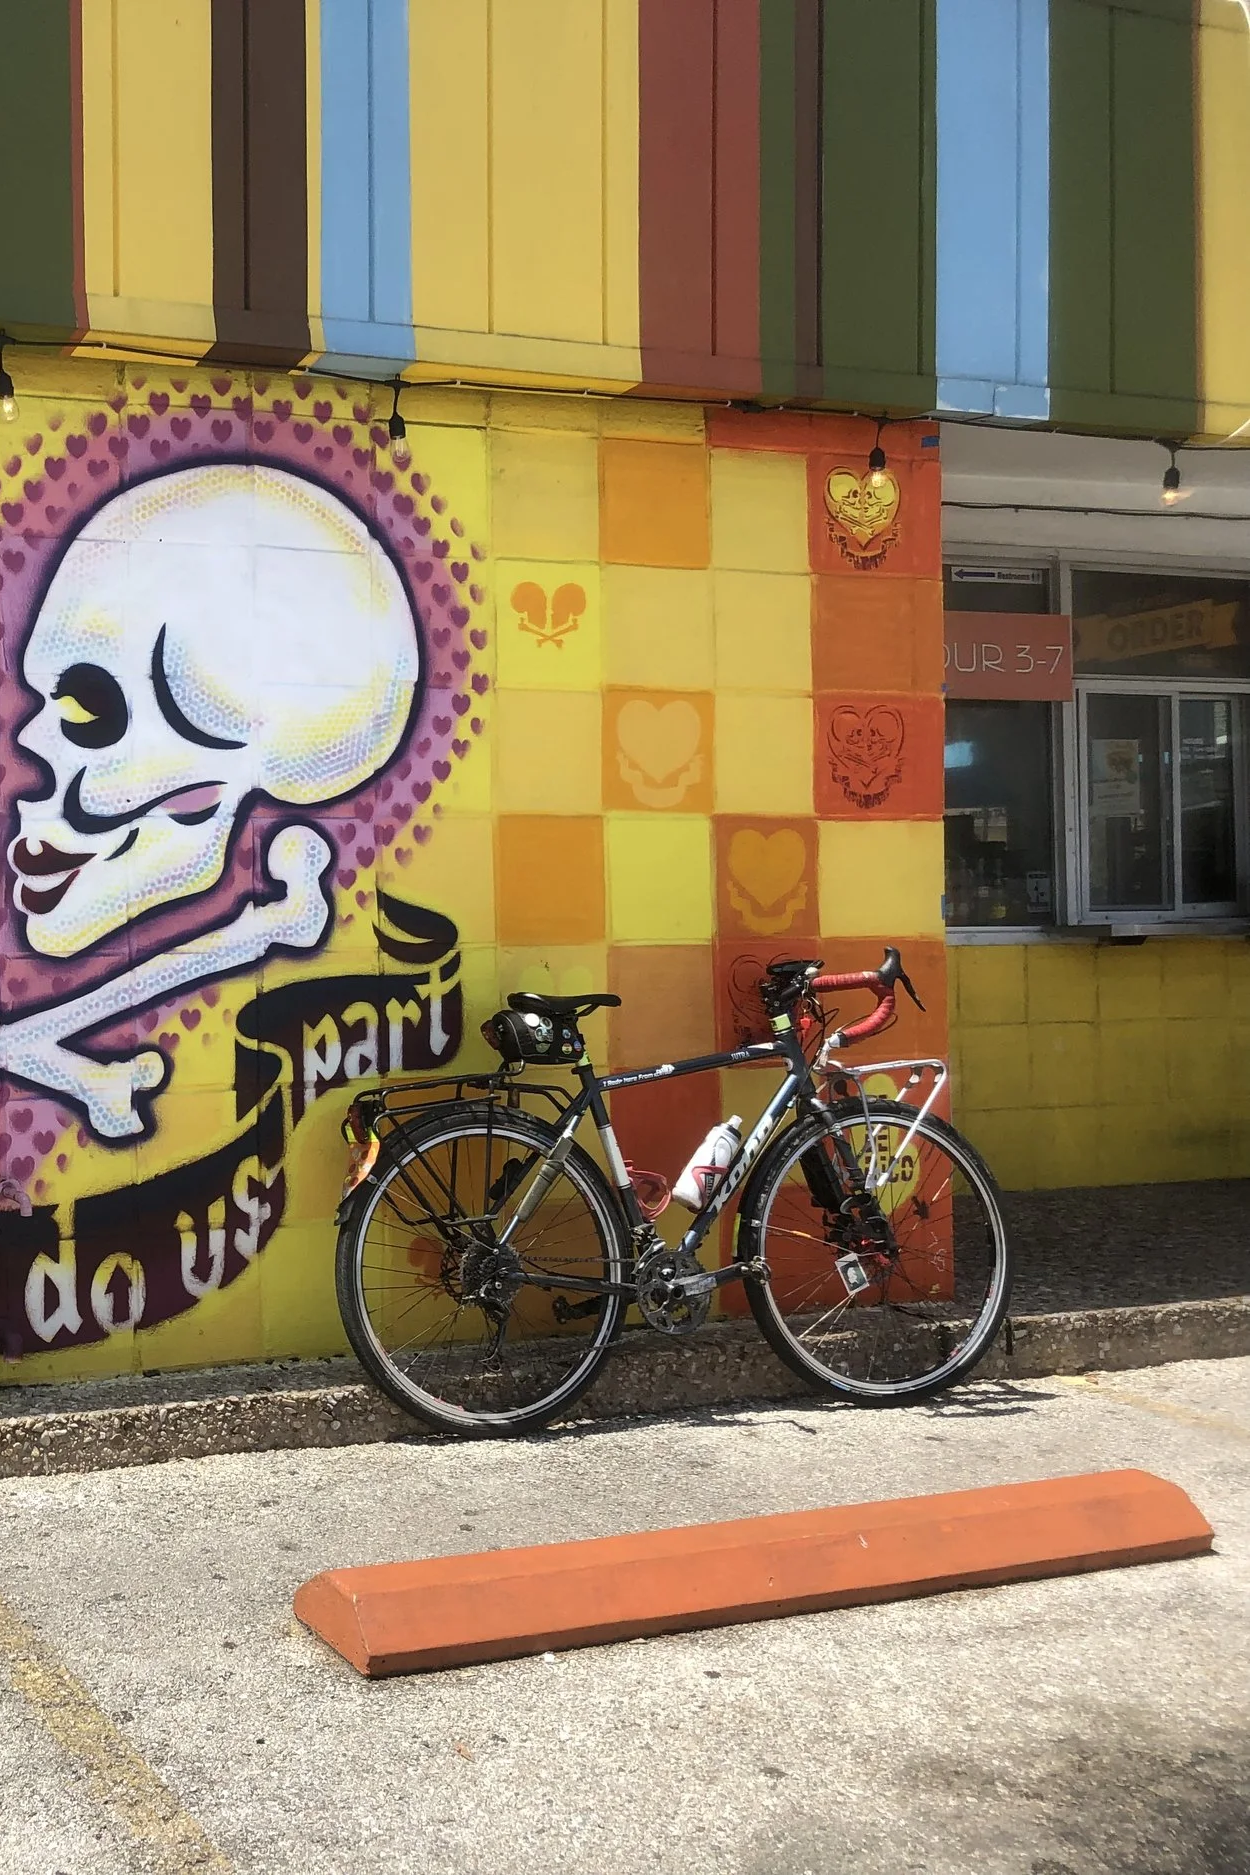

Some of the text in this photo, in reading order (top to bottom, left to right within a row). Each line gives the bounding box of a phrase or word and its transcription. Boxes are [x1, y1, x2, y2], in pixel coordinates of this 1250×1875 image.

[1107, 608, 1205, 652] ORDER
[1016, 645, 1066, 675] 3-7
[25, 1198, 148, 1344] do
[173, 1155, 282, 1299] us
[302, 962, 462, 1104] part
